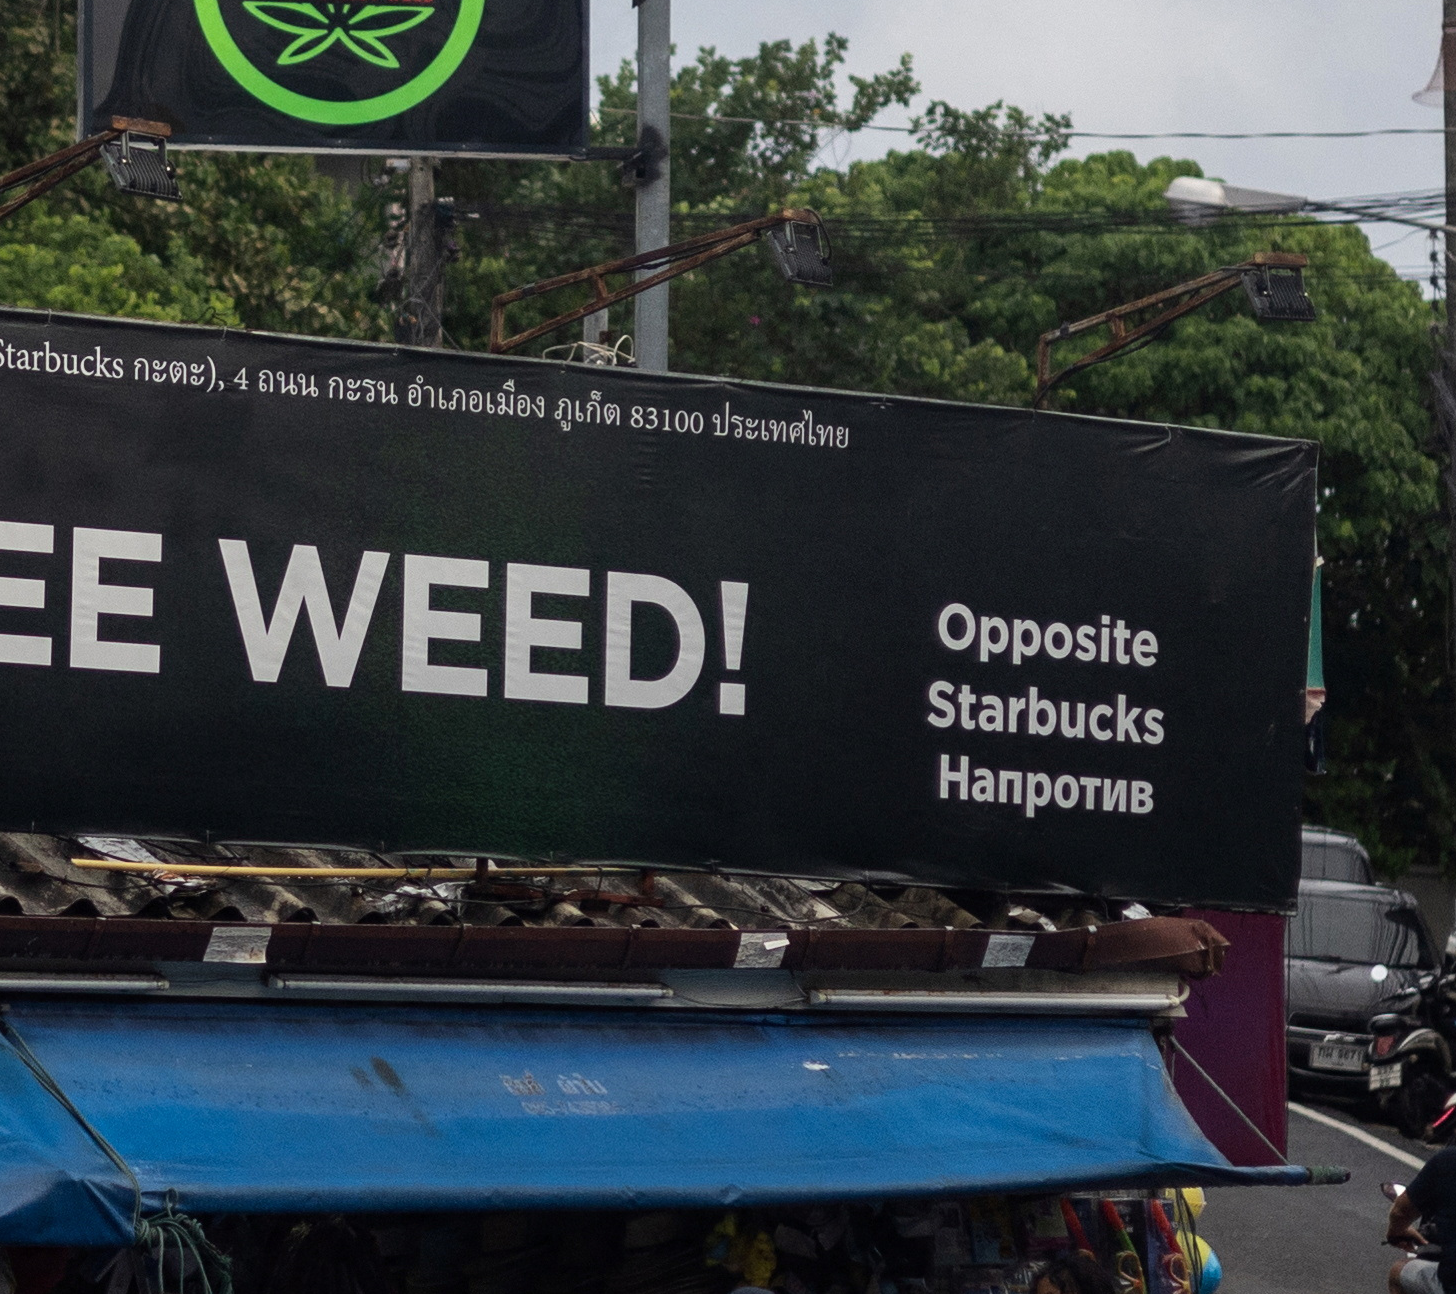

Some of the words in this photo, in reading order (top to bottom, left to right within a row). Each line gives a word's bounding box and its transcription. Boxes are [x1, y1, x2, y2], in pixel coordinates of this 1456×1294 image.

[233, 370, 250, 392] 4
[257, 365, 319, 397] ถนน
[328, 373, 398, 405] กะรน
[407, 378, 546, 419] อำเภอเมือง
[554, 391, 621, 432] ภูเก็ต
[630, 410, 704, 436] 83100
[711, 402, 850, 449] ประเทศไทย
[218, 538, 749, 716] WEED!
[937, 603, 1159, 667] Opposite
[927, 680, 1165, 745] Starbucks
[939, 754, 1154, 818] Напротив
